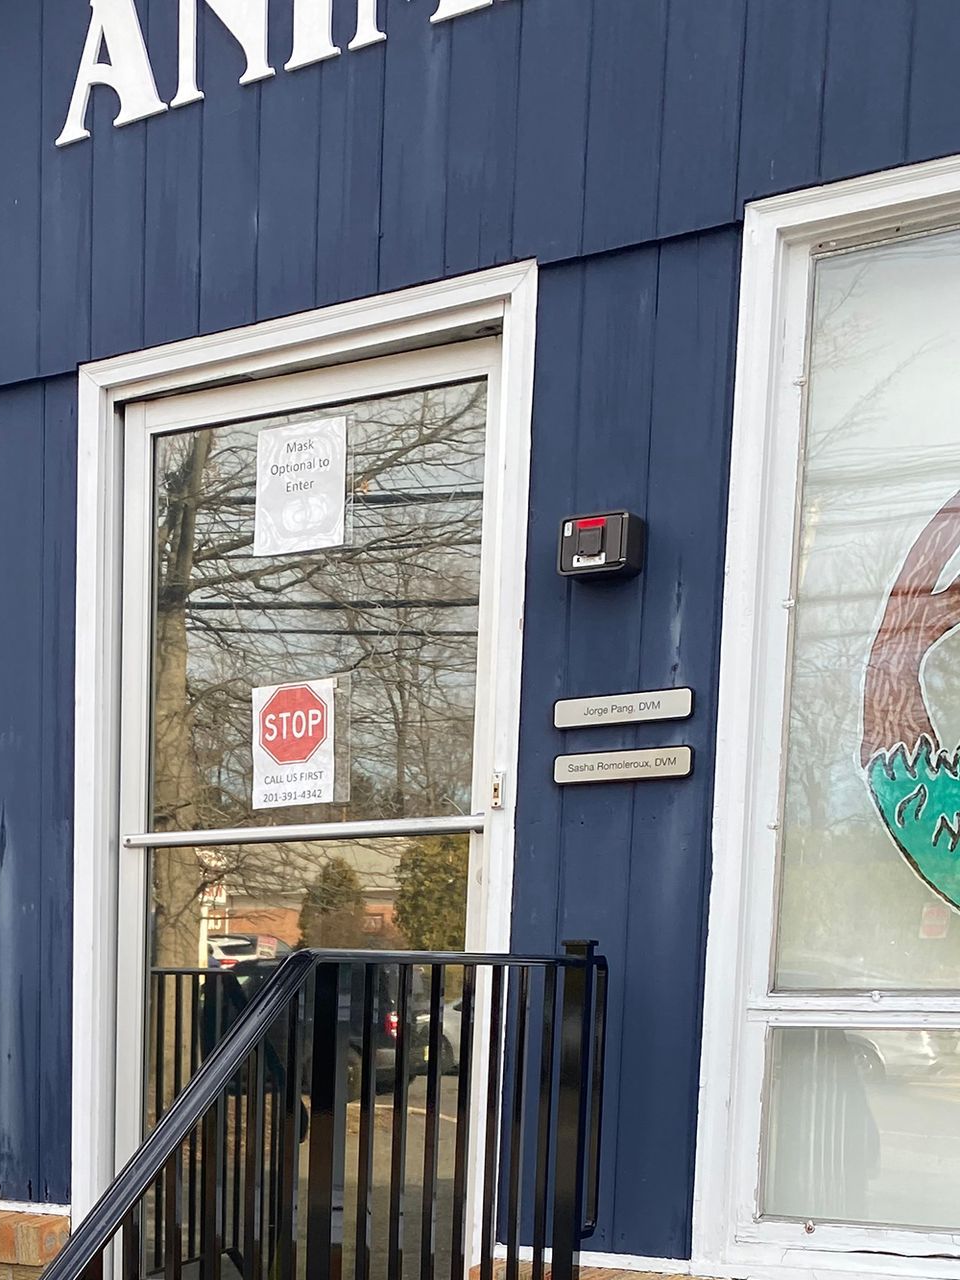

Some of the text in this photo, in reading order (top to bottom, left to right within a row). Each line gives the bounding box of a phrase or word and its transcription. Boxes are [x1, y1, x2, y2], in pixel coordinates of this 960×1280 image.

[286, 439, 314, 454] Mask
[270, 458, 330, 476] Optional to
[286, 480, 314, 493] Enter
[583, 706, 608, 717] Jorge
[638, 701, 661, 711] DVM
[264, 709, 322, 742] STOP
[567, 763, 595, 773] Sasha
[654, 757, 677, 767] DVM
[264, 771, 324, 785] CALL US FIRST
[263, 789, 322, 803] 201-391-4342
